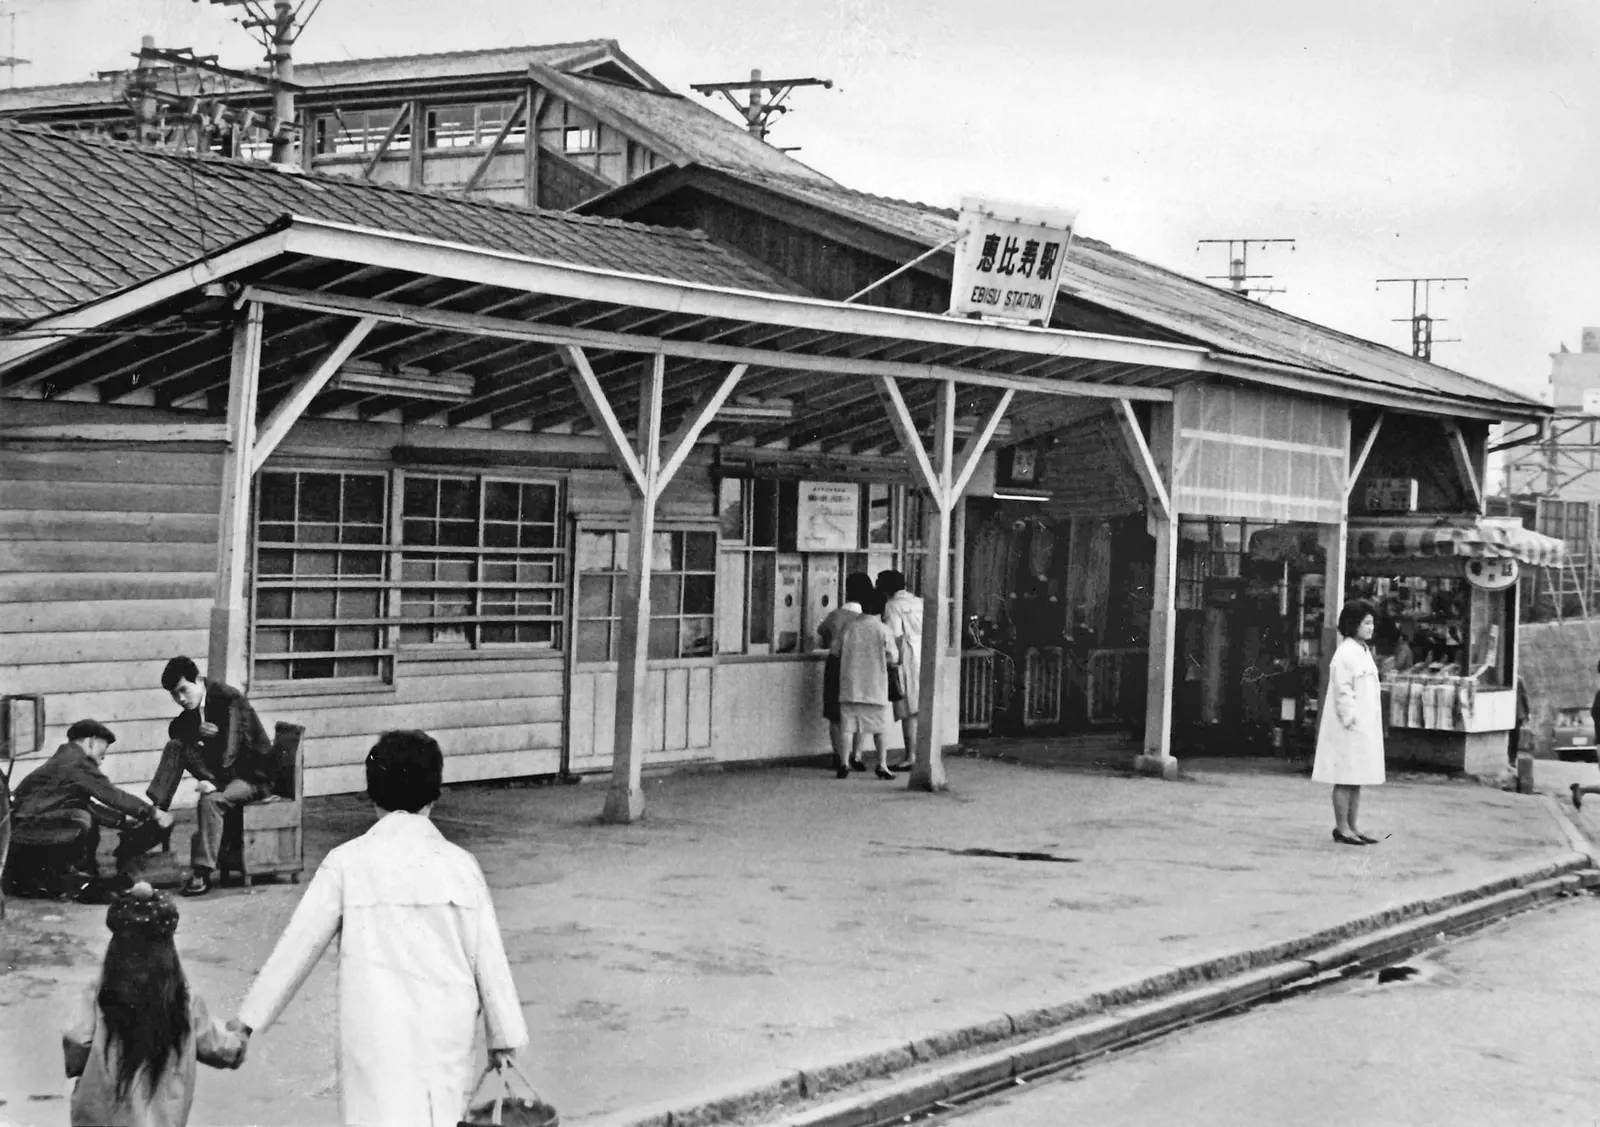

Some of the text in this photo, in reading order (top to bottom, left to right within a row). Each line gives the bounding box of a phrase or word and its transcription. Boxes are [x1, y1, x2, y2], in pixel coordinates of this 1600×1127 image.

[976, 233, 1060, 280] 恵比寿駅
[971, 286, 1044, 309] EBISU STATION
